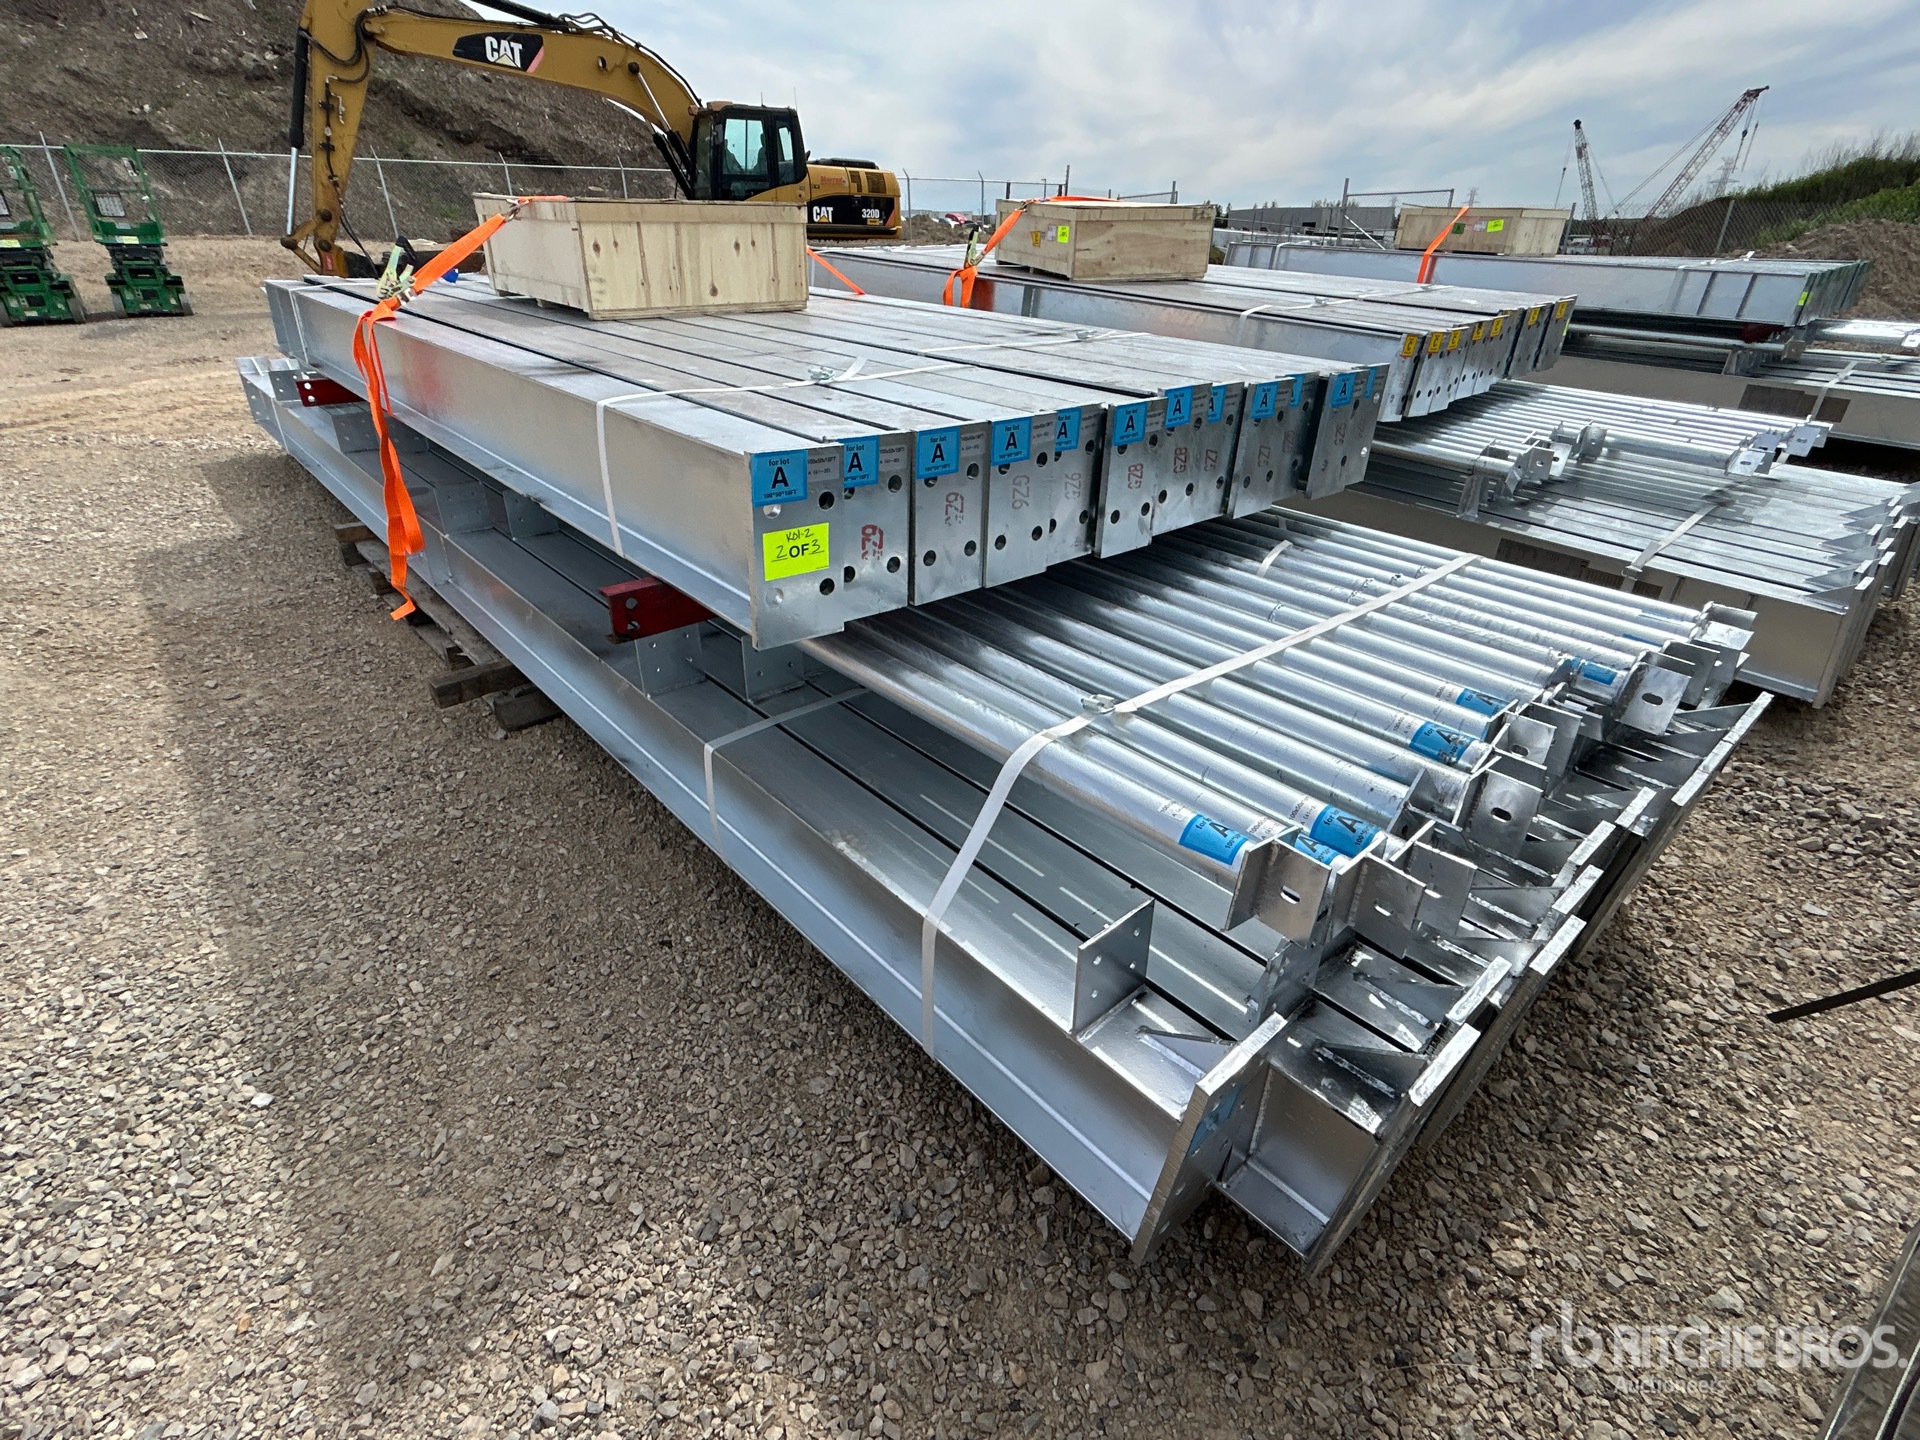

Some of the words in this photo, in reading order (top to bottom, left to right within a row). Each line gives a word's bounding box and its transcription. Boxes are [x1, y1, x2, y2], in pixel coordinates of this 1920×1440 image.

[485, 36, 522, 68] CAT
[813, 206, 833, 223] CAT
[861, 208, 880, 218] 320D
[1339, 382, 1347, 397] A
[1172, 398, 1182, 416] A
[1260, 392, 1268, 408] A
[1057, 421, 1068, 439] A
[1124, 415, 1135, 432] A
[1005, 432, 1018, 451] A
[931, 443, 945, 463] A
[1172, 446, 1188, 474] GZ8
[768, 458, 779, 467] for
[848, 452, 863, 473] A
[771, 466, 789, 489] A
[1127, 462, 1144, 490] GZ8
[1011, 473, 1031, 511] GZ6
[1064, 471, 1082, 501] GZ6
[775, 544, 788, 559] 2
[789, 543, 810, 558] OF
[811, 538, 822, 554] 3
[1475, 693, 1496, 706] A
[1423, 727, 1434, 737] for
[1435, 728, 1458, 745] A
[1195, 819, 1207, 830] for
[1323, 814, 1333, 826] for
[1336, 815, 1364, 834] A
[1208, 821, 1231, 838] A
[1298, 835, 1320, 854] A
